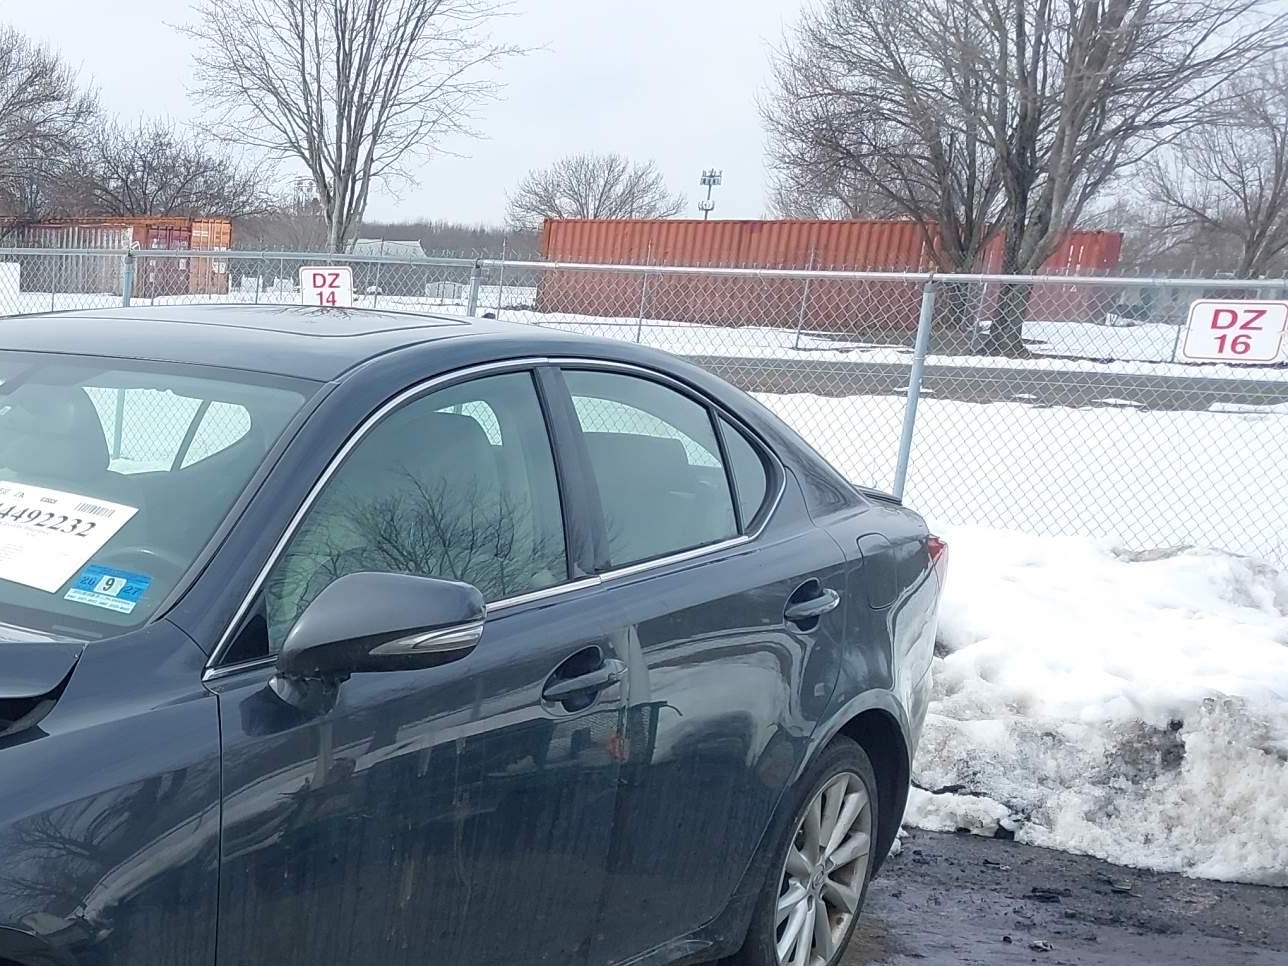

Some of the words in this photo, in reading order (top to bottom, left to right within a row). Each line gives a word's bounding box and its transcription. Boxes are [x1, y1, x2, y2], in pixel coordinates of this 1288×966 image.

[313, 273, 341, 288] DZ
[316, 291, 337, 305] 14
[1210, 309, 1268, 330] DZ
[1214, 334, 1252, 354] 16
[102, 578, 115, 592] 9
